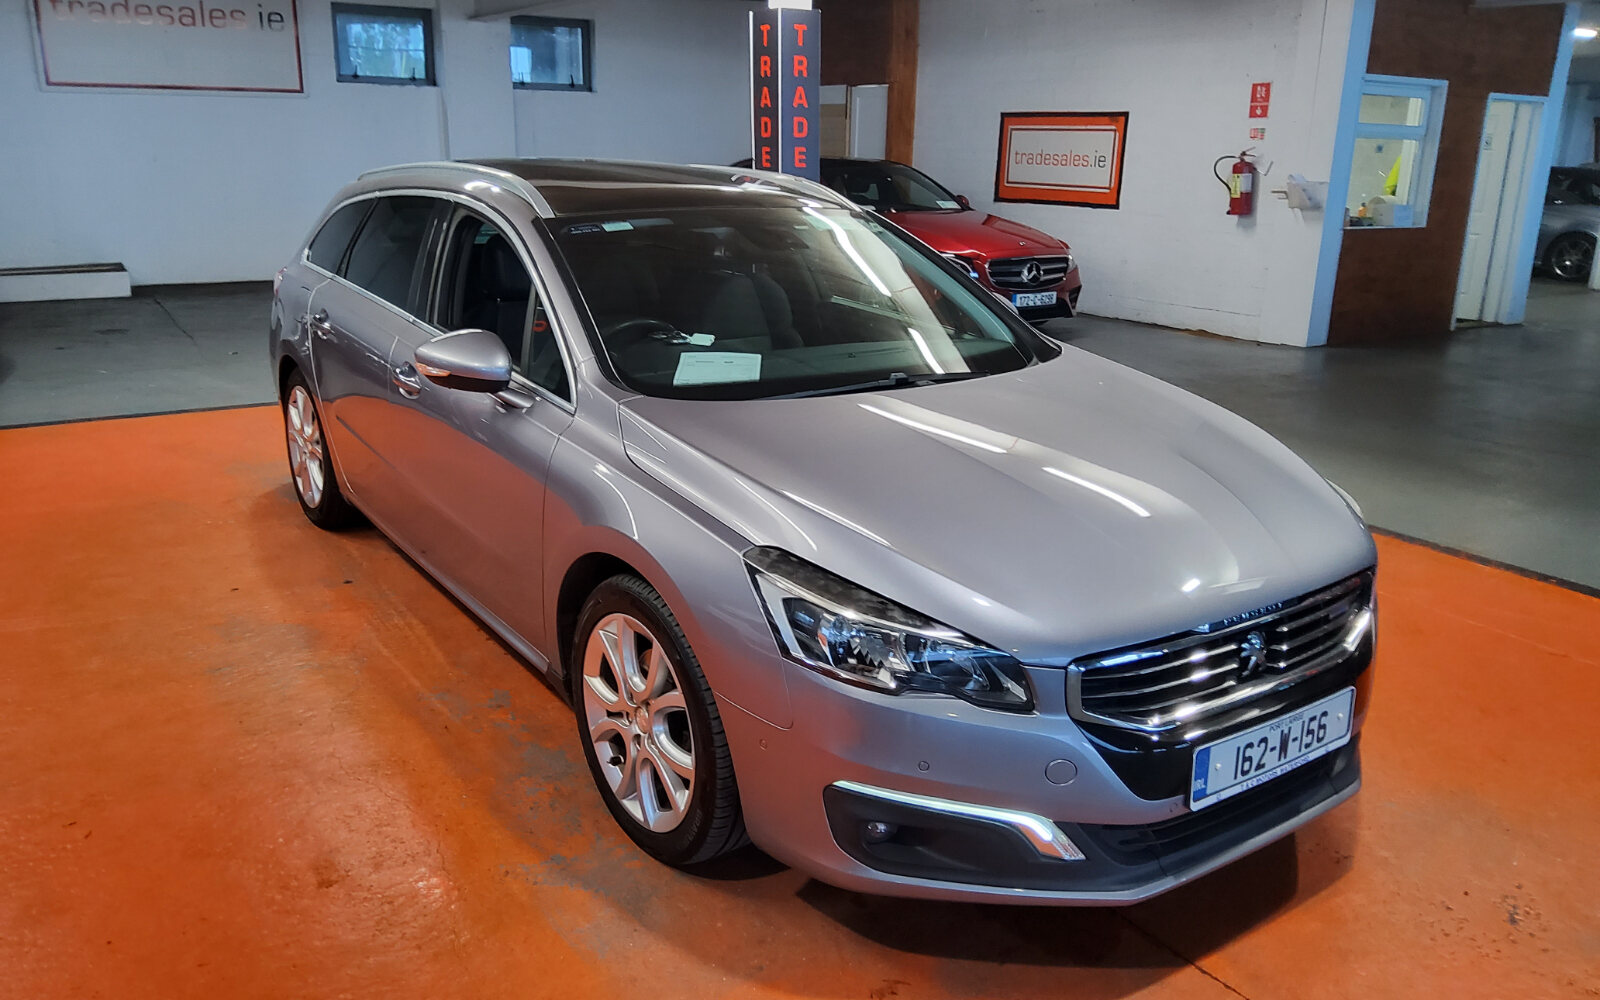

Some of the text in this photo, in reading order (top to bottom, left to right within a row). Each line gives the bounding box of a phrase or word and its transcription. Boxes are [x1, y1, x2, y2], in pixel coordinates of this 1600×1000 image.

[760, 24, 772, 168] TRADE
[793, 23, 808, 168] TRADE
[1014, 149, 1107, 168] tradesales.ie
[1233, 710, 1329, 780] 162-W-156
